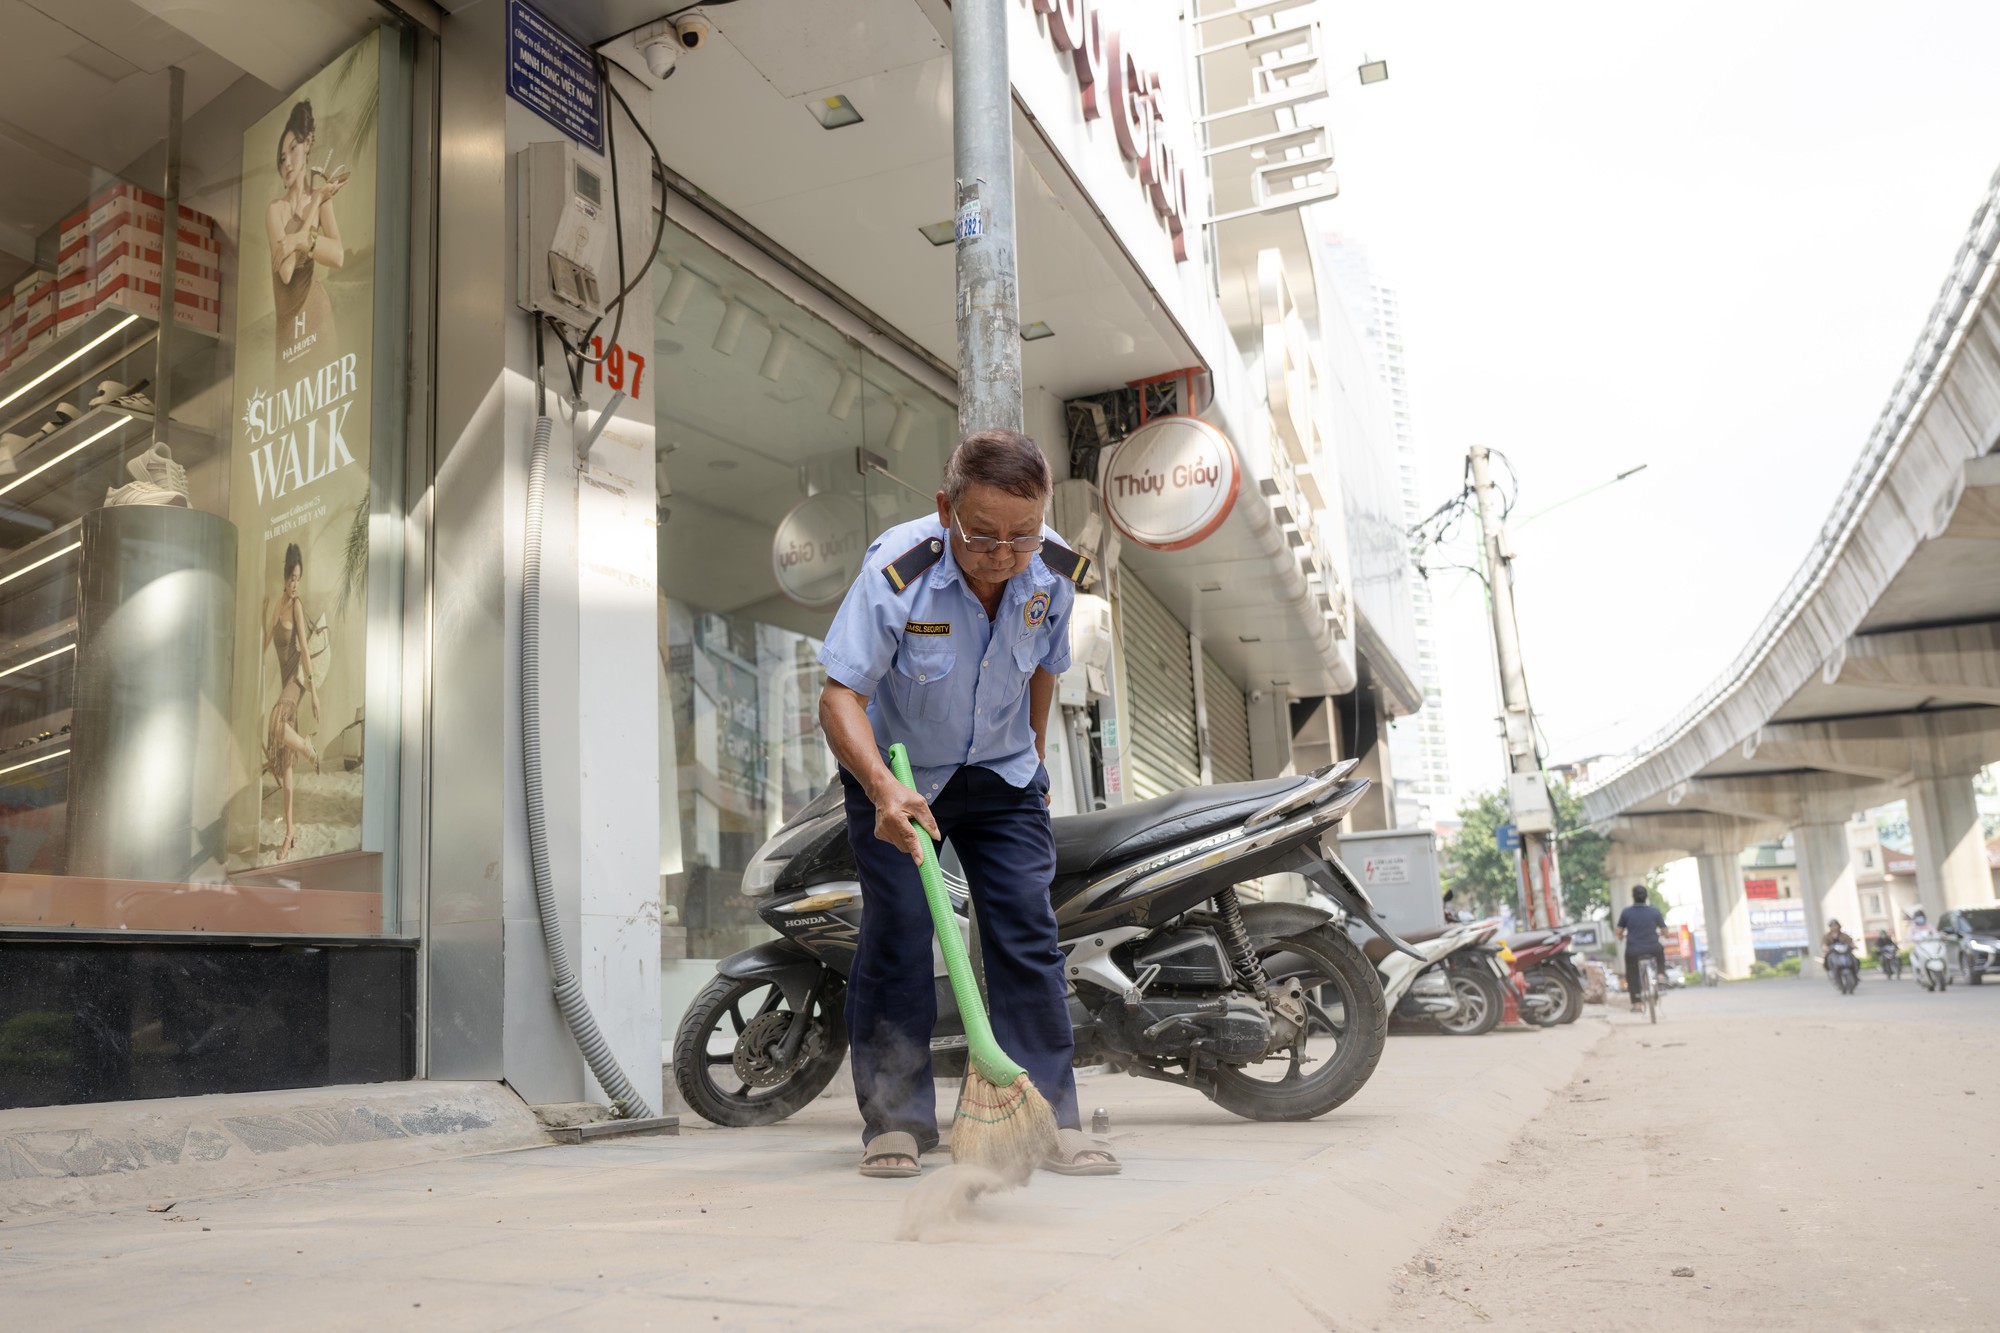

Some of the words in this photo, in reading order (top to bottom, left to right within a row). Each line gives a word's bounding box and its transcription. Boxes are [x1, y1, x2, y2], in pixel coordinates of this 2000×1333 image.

[520, 47, 540, 73] MINH
[541, 62, 560, 87] LONG
[561, 76, 576, 97] VIỆT
[576, 88, 593, 110] NAM
[248, 352, 358, 444] SUMMER
[590, 335, 645, 399] 197
[248, 400, 356, 507] WALK
[1114, 468, 1165, 497] Thúy
[270, 511, 289, 525] Summer
[785, 916, 827, 927] HONDA
